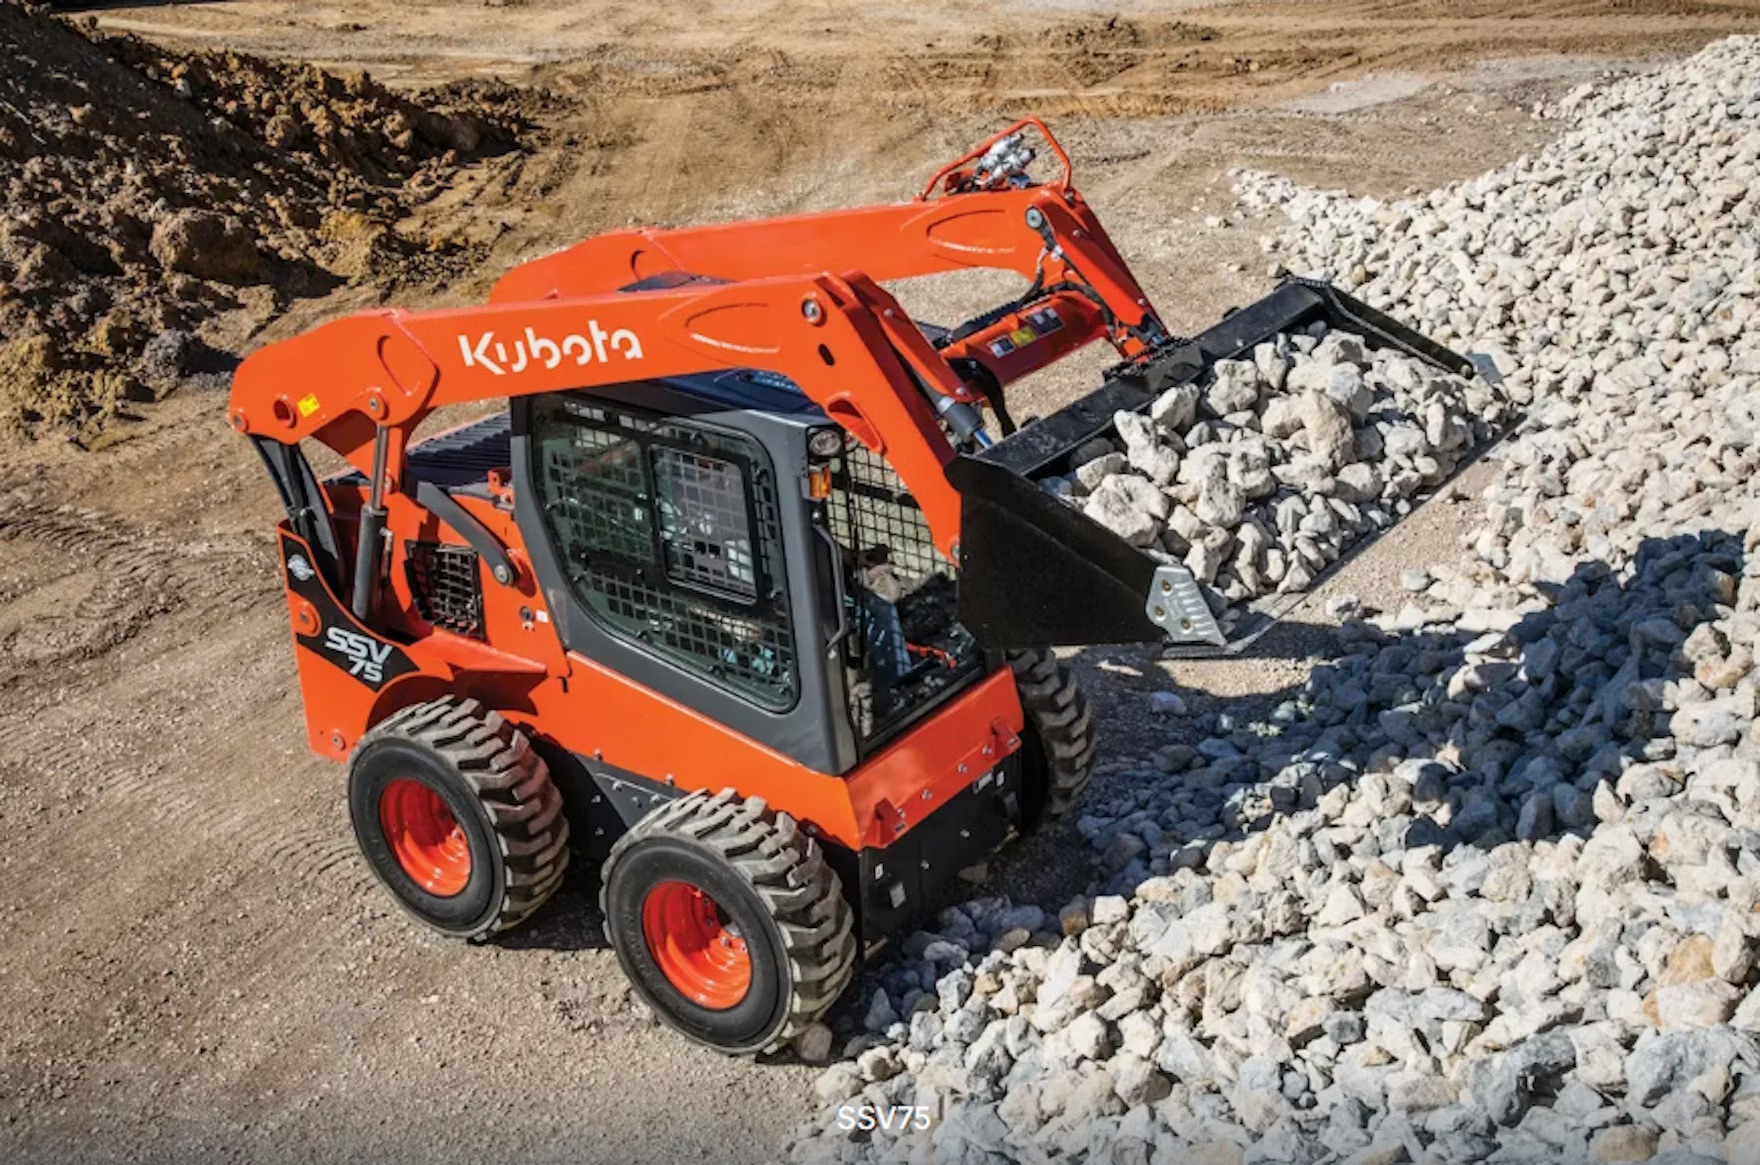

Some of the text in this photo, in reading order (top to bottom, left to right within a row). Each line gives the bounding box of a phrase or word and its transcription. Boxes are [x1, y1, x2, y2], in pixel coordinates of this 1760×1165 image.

[457, 319, 643, 375] Kubota
[324, 626, 393, 664] SSV
[348, 655, 383, 682] 75
